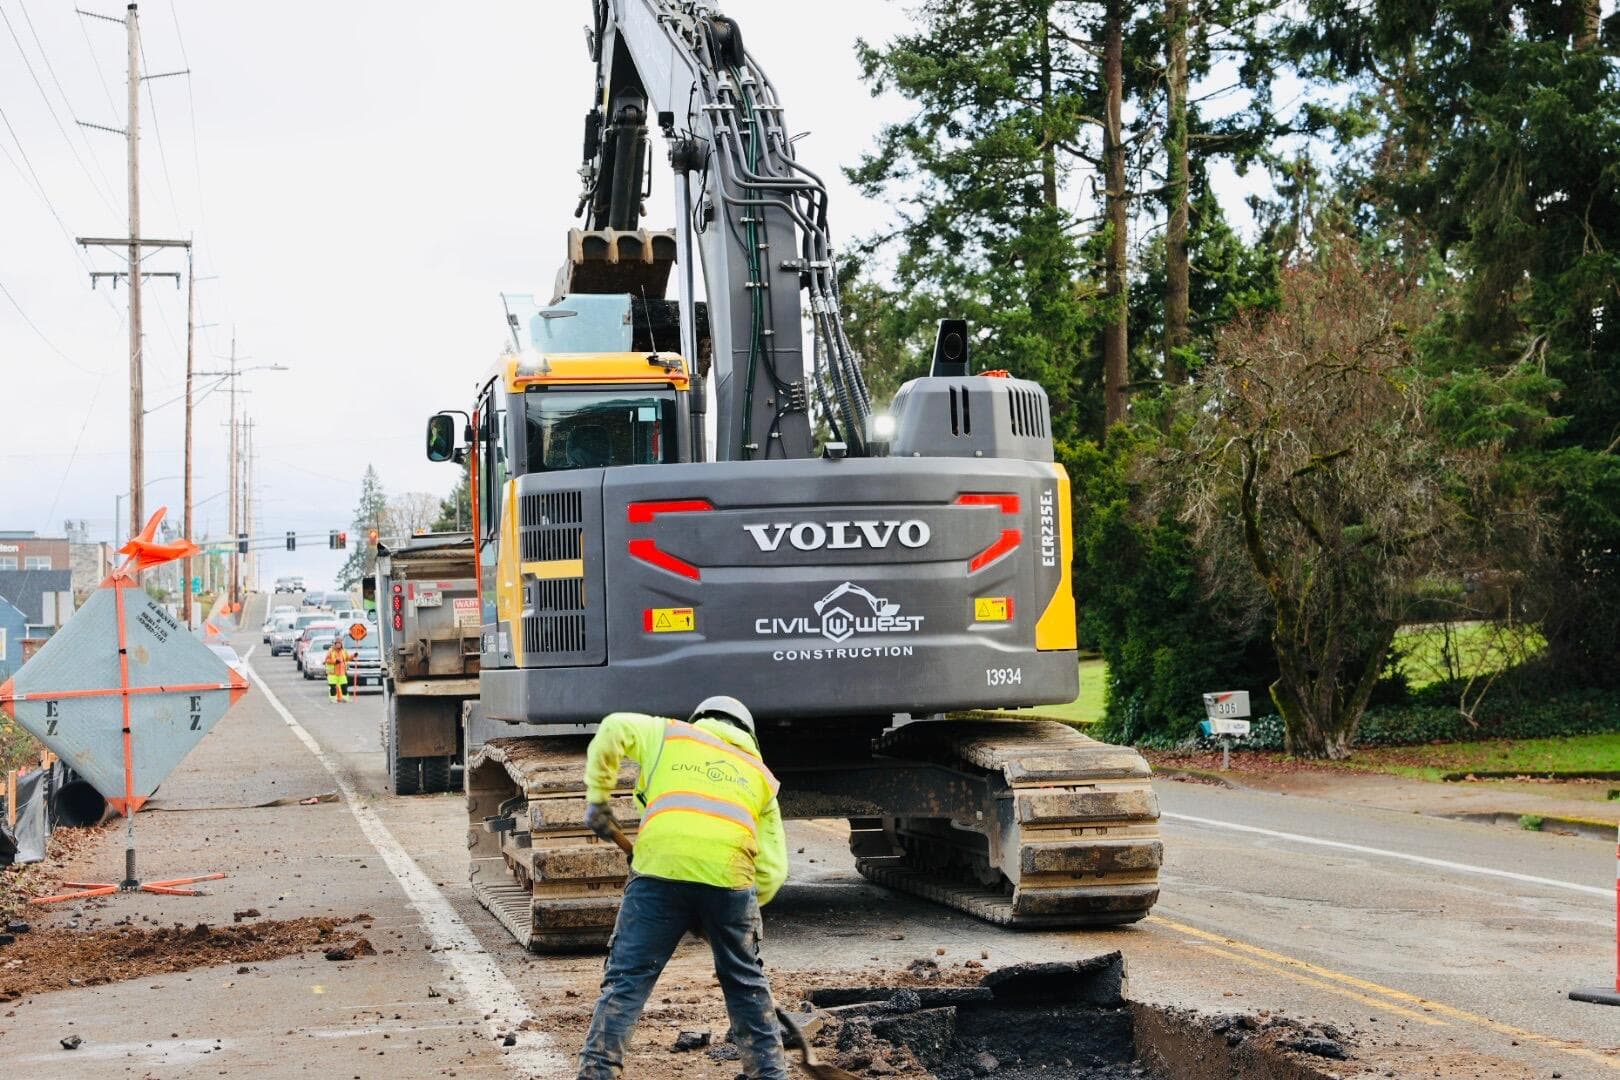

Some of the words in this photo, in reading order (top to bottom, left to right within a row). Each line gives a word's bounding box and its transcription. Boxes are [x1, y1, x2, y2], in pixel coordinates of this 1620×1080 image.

[743, 519, 931, 551] VOLVO
[1040, 488, 1055, 567] ECR235EL
[755, 617, 820, 634] CIVIL
[773, 646, 913, 661] CONSTRUCTION
[986, 668, 1022, 685] 13934
[671, 763, 705, 775] CIVIL
